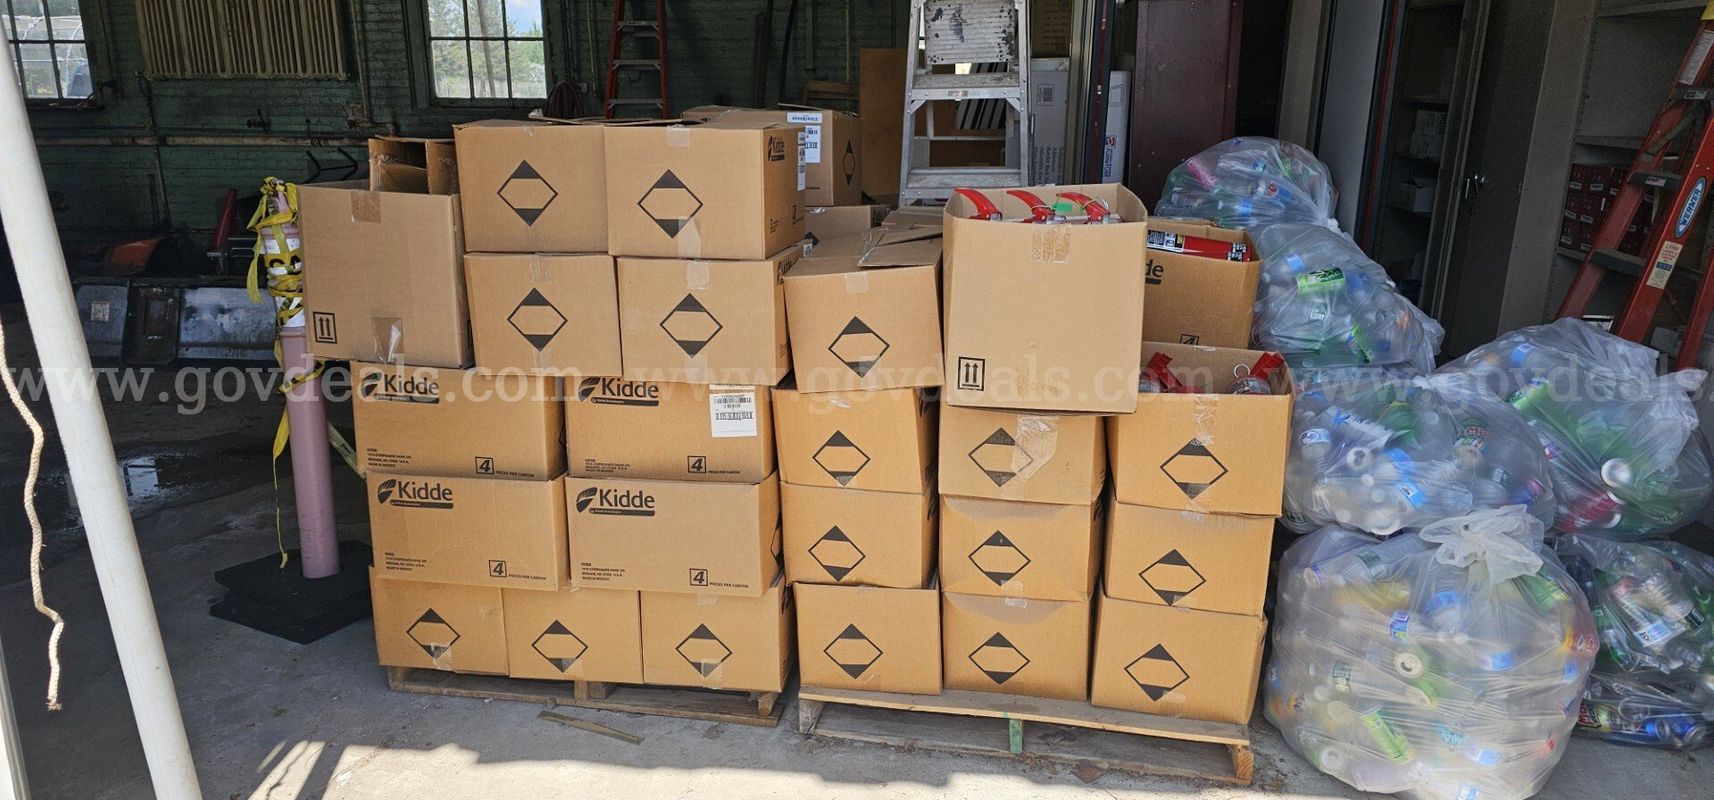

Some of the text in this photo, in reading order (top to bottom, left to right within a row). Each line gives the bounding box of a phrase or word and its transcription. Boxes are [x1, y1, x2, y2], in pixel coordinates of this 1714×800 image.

[1680, 189, 1701, 225] WERNER
[384, 374, 439, 395] Kidde
[602, 377, 659, 398] Kidde
[479, 459, 491, 472] 4
[691, 458, 703, 471] 4
[398, 480, 453, 501] Kidde
[599, 488, 655, 509] Kidde
[493, 562, 504, 575] 4
[693, 571, 705, 584] 4
